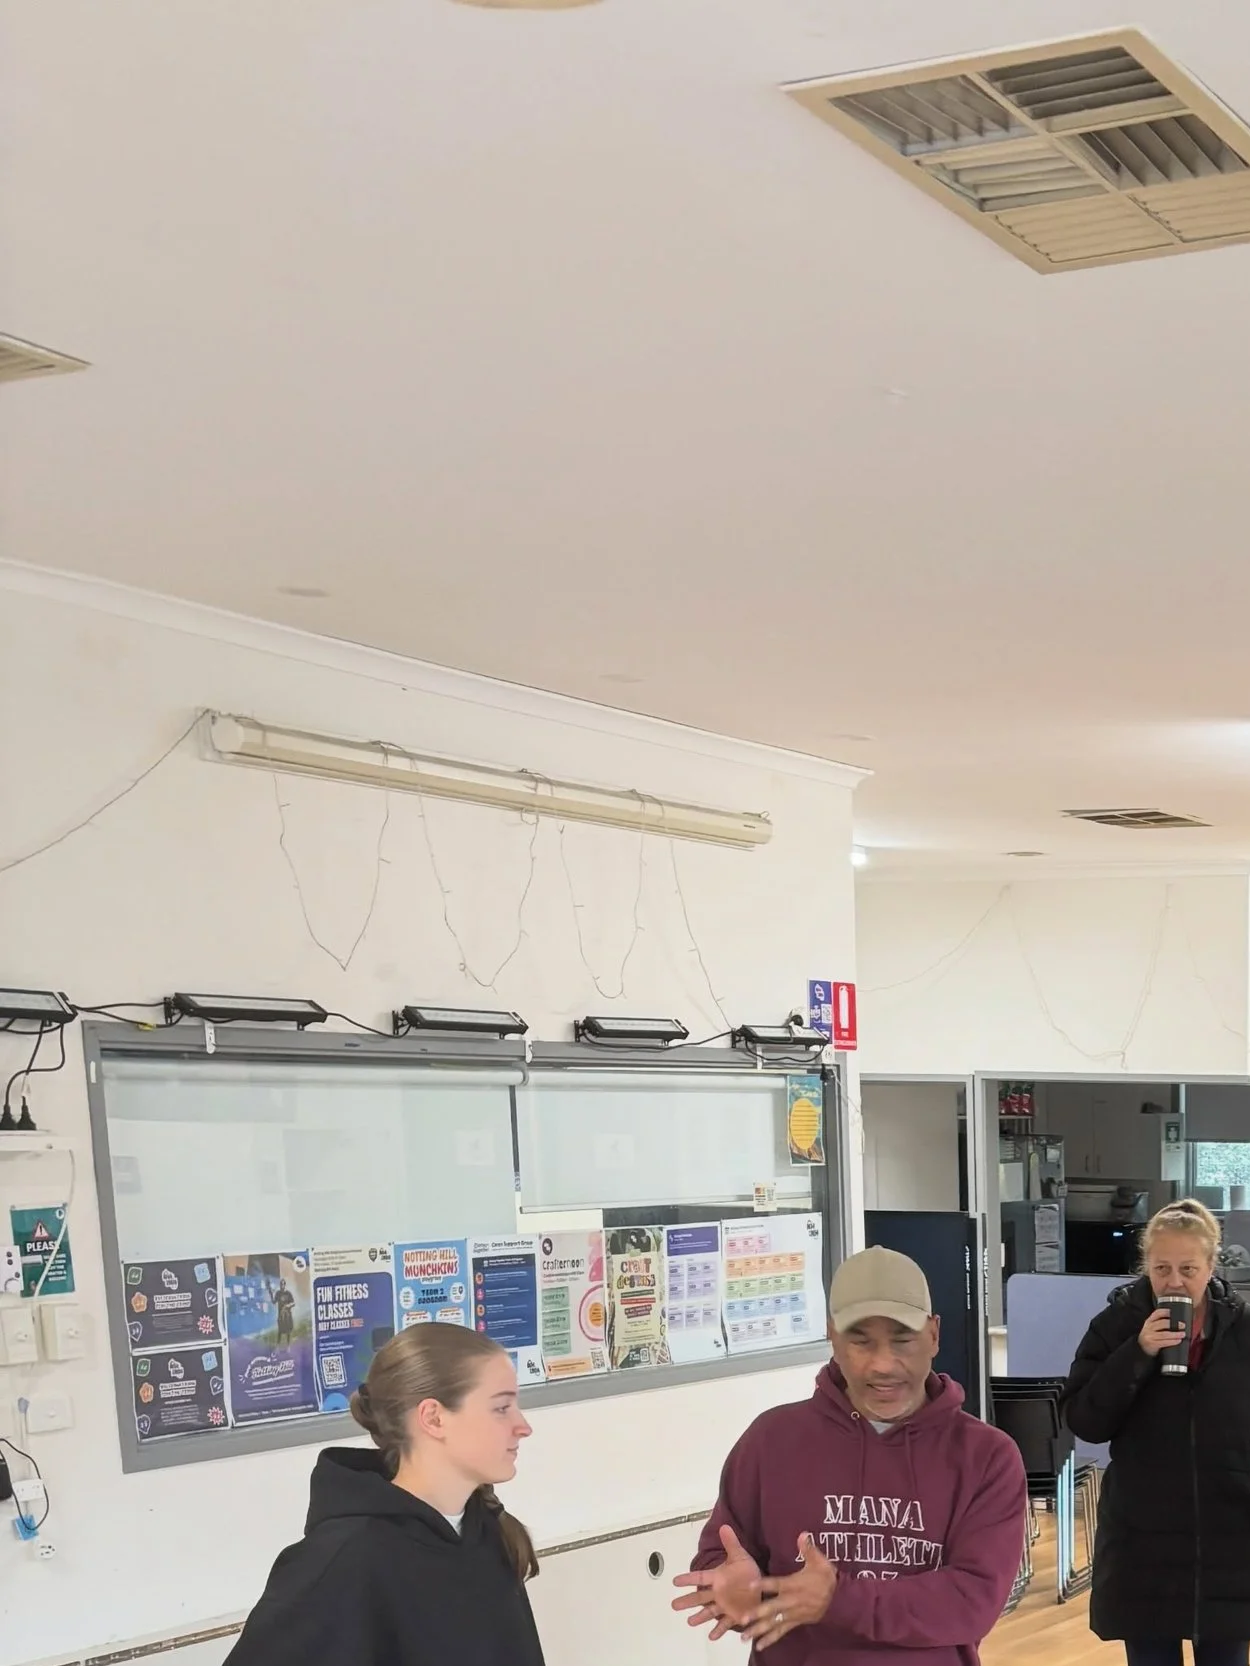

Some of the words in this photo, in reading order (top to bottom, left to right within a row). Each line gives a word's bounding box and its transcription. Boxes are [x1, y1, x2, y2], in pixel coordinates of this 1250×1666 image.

[404, 1250, 438, 1262] NOTTING
[439, 1248, 458, 1260] HILL
[404, 1261, 458, 1277] MUNCHKINS
[316, 1286, 333, 1304] FUN
[334, 1283, 369, 1302] FITNESS
[318, 1302, 354, 1321] CLASSES
[824, 1495, 925, 1531] MANA
